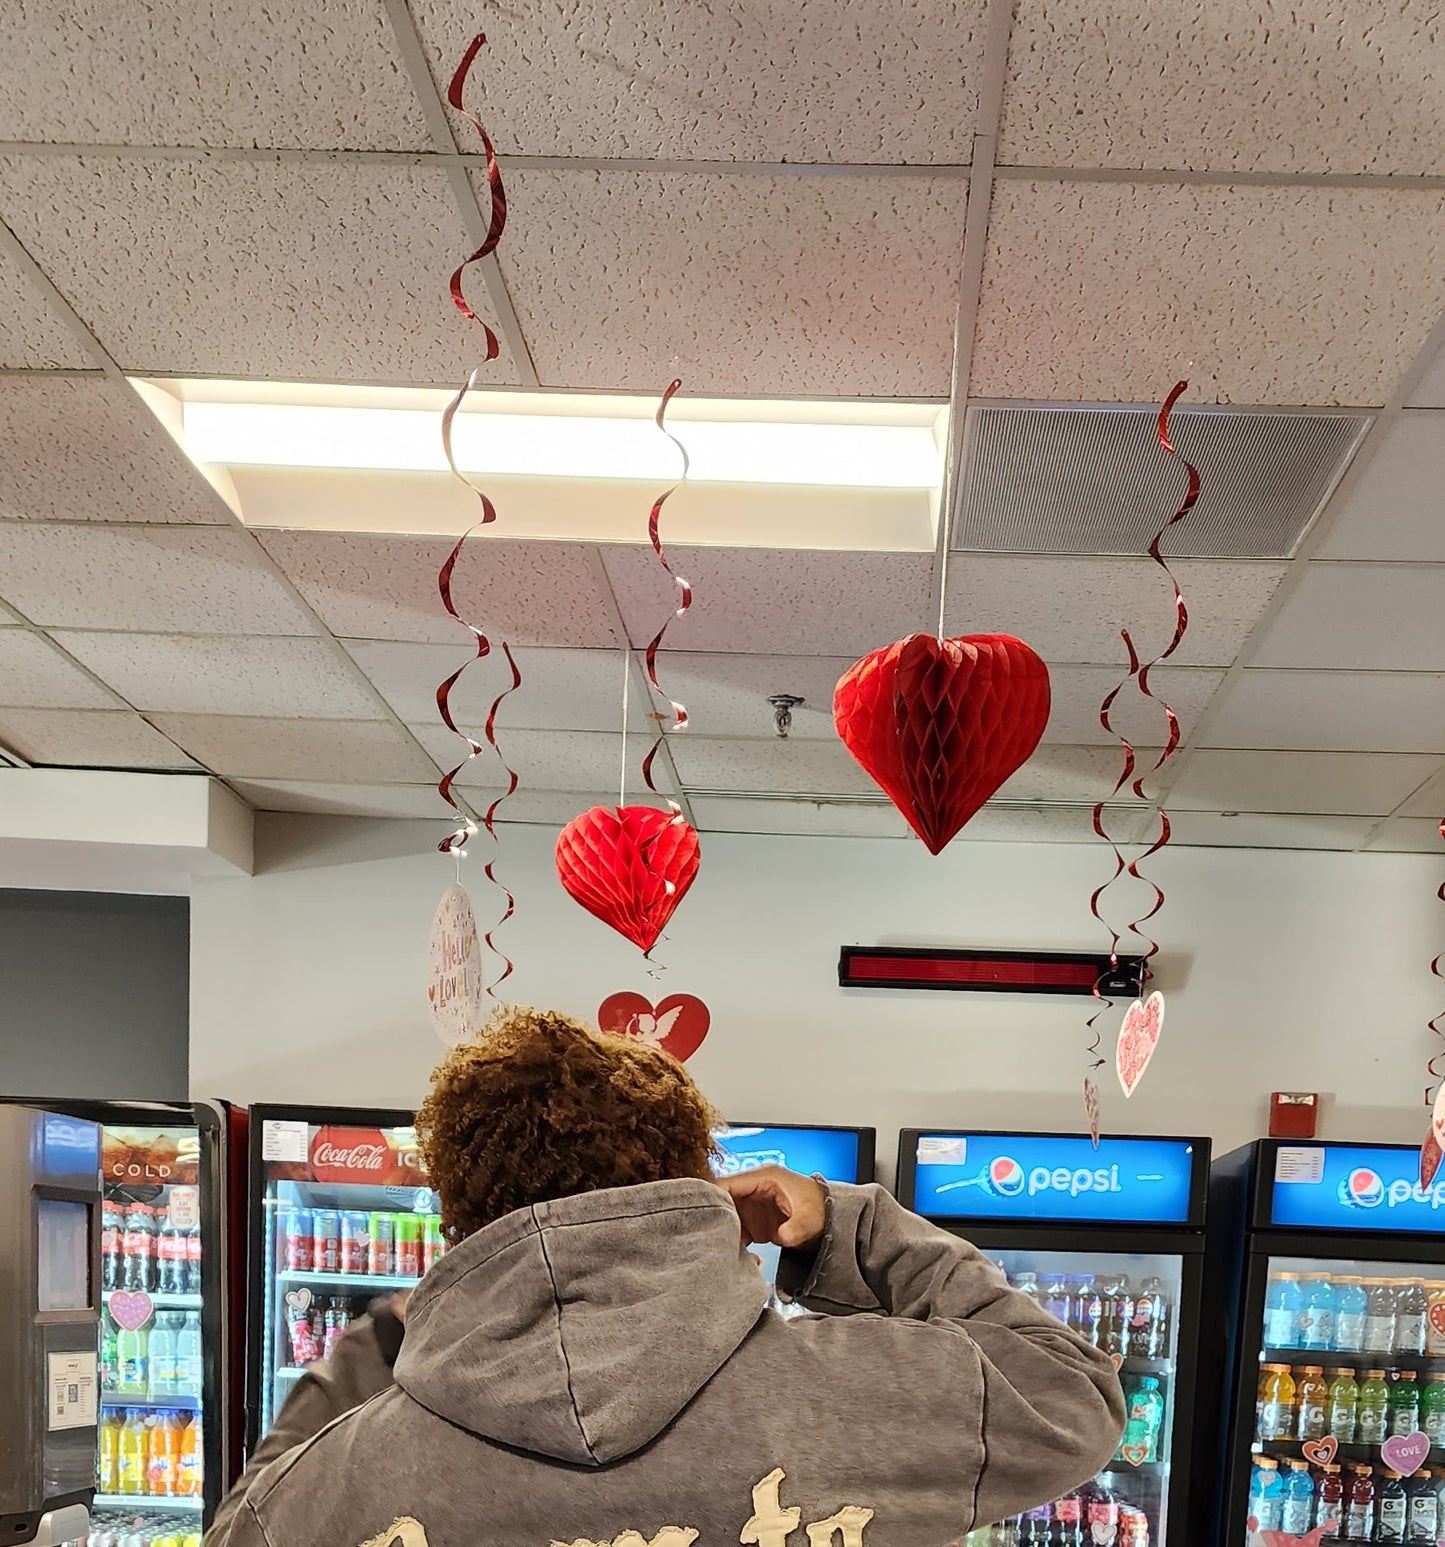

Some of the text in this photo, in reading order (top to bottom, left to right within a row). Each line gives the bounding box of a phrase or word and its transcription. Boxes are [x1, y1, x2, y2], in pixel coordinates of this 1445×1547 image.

[112, 1163, 171, 1177] COLD
[1028, 1163, 1122, 1196] pepsi
[1395, 1445, 1421, 1457] LOVE
